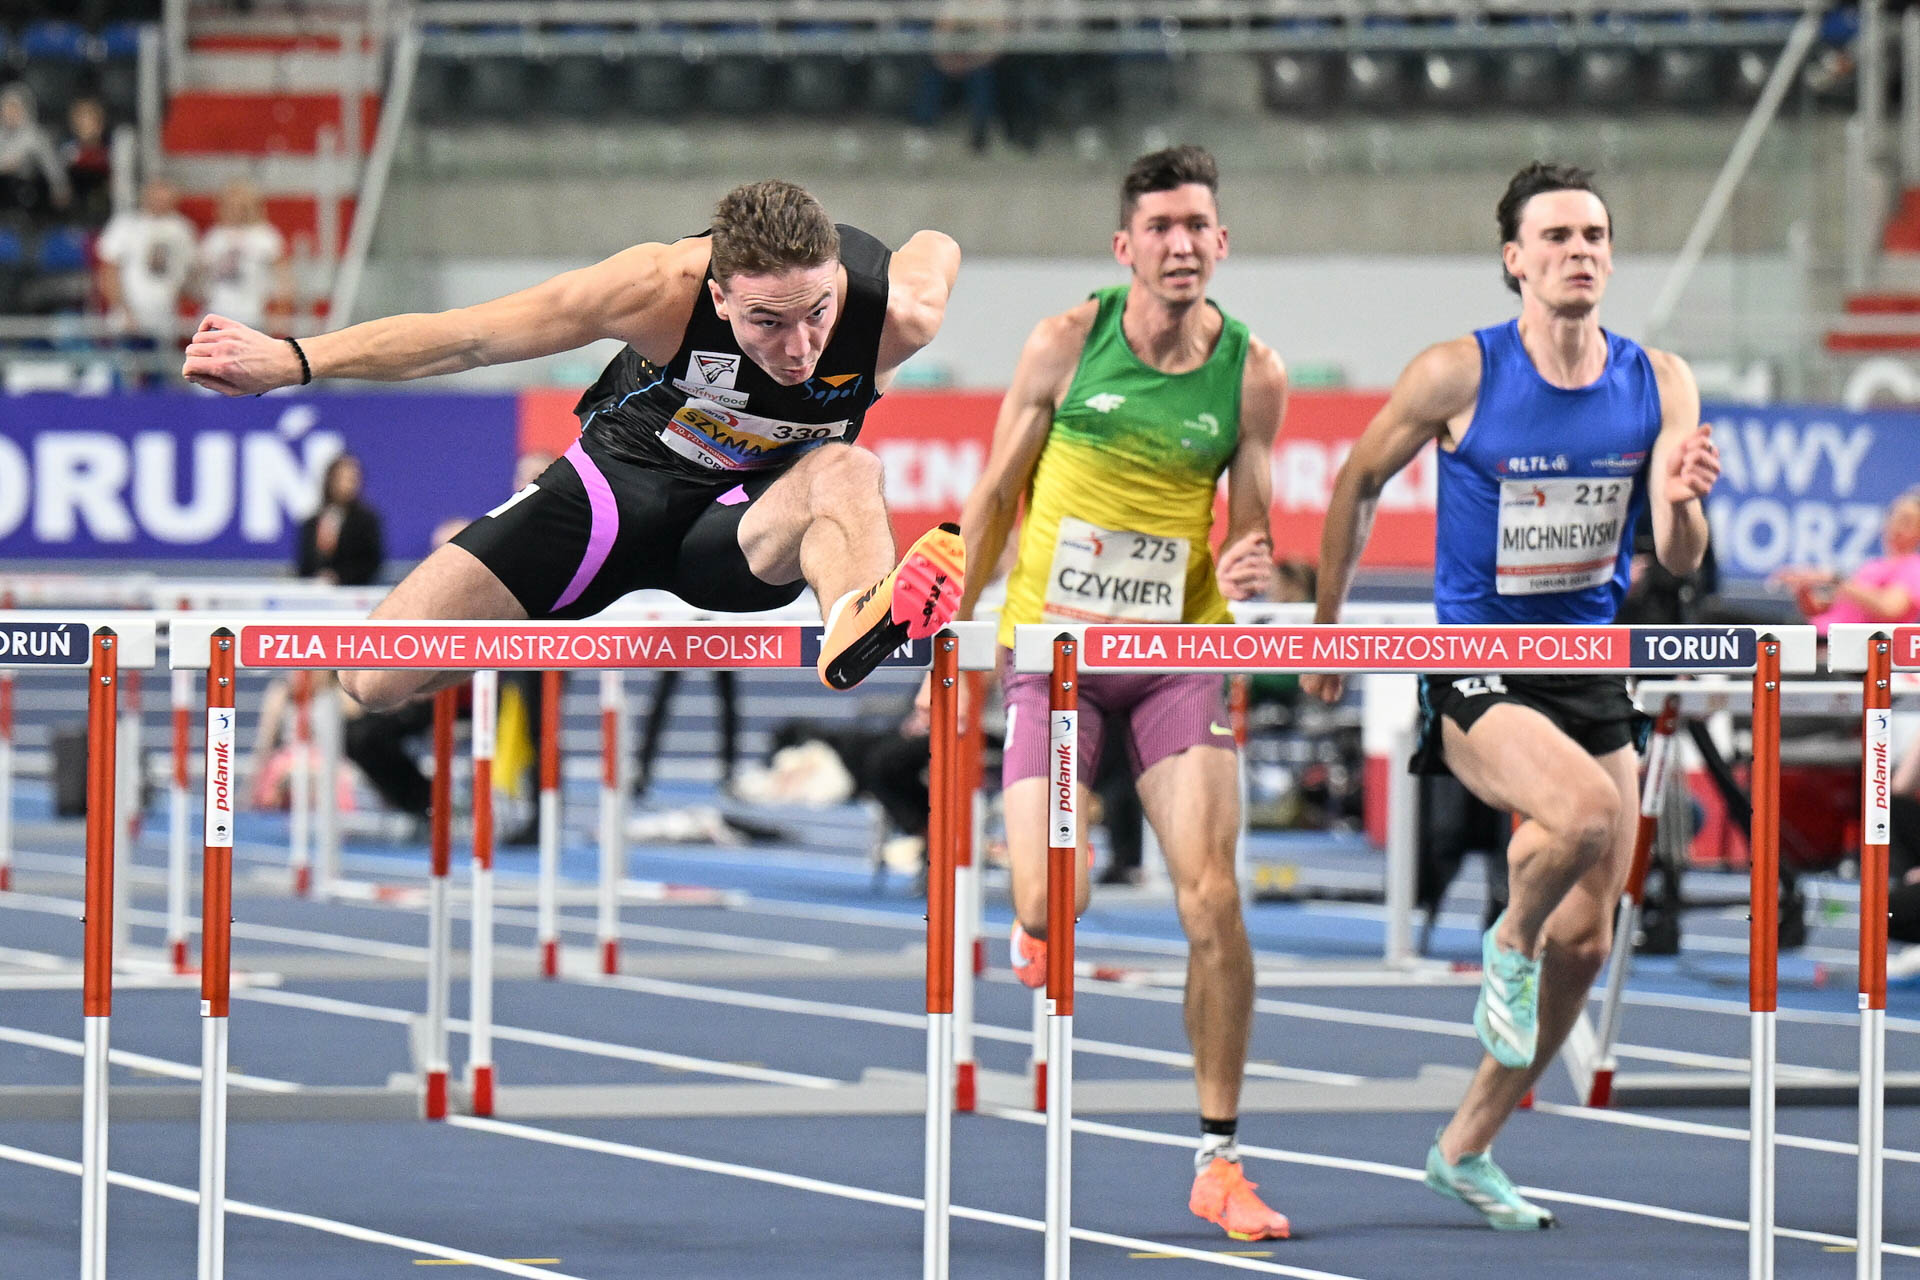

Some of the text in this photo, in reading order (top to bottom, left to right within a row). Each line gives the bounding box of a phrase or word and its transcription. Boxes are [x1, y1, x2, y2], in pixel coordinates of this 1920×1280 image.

[772, 425, 831, 439] 330
[0, 405, 345, 543] RUŃ
[1574, 484, 1620, 506] 212
[1131, 537, 1177, 563] 275
[1503, 519, 1618, 550] MICHNIEWSKI
[1058, 567, 1171, 606] CZYKIER
[259, 634, 783, 661] PZLA HALOWE MISTRZOSTWA POLSKI
[1102, 629, 1739, 661] PZLA HALOWE MISTRZOSTWA POLSKI TORUŃ
[213, 741, 230, 812] polanik
[1056, 743, 1073, 813] polanik
[1873, 741, 1888, 809] polanik
